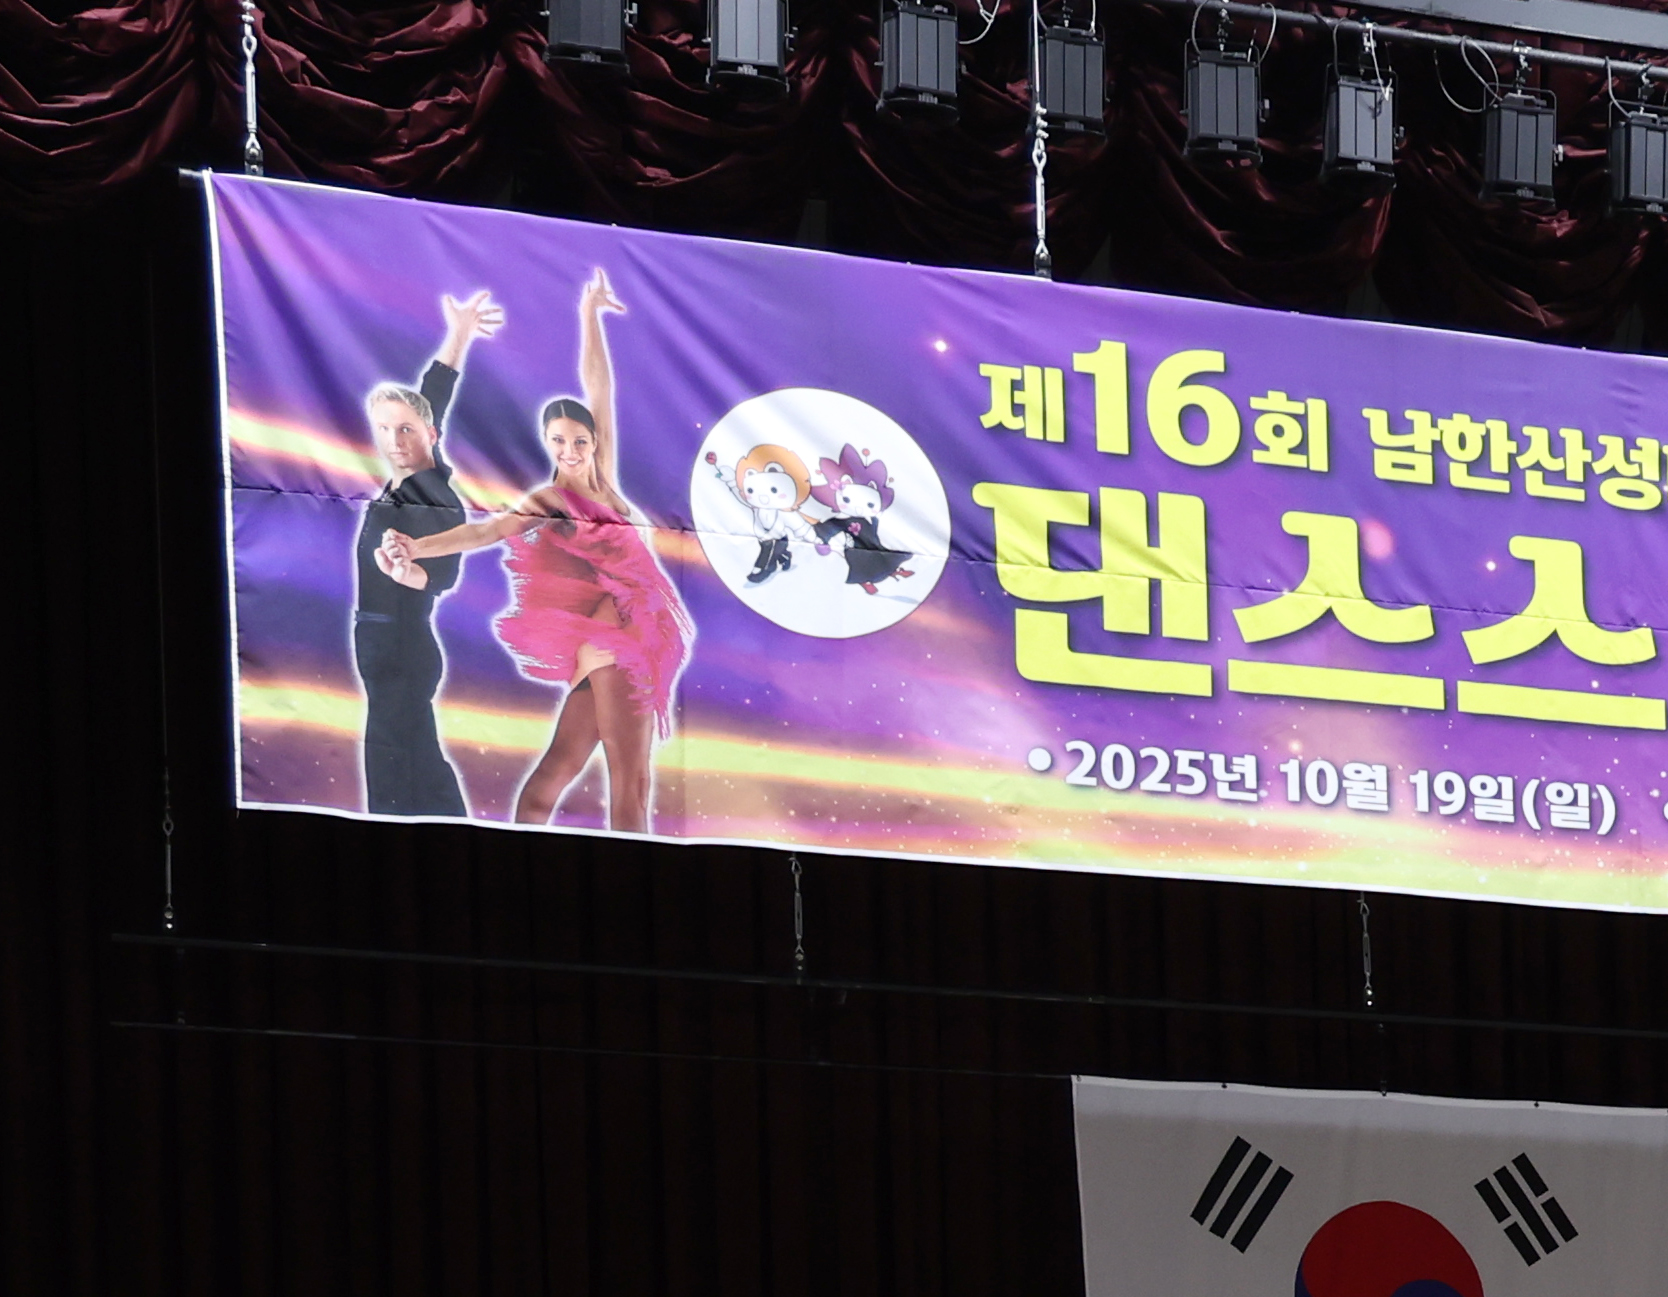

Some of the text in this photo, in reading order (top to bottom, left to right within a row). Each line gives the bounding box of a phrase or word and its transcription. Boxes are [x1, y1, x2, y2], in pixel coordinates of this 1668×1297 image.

[979, 340, 1328, 473] 제16회
[1065, 741, 1259, 802] 2025년
[1279, 759, 1389, 811] 10월
[1409, 767, 1617, 835] 19일(일)
